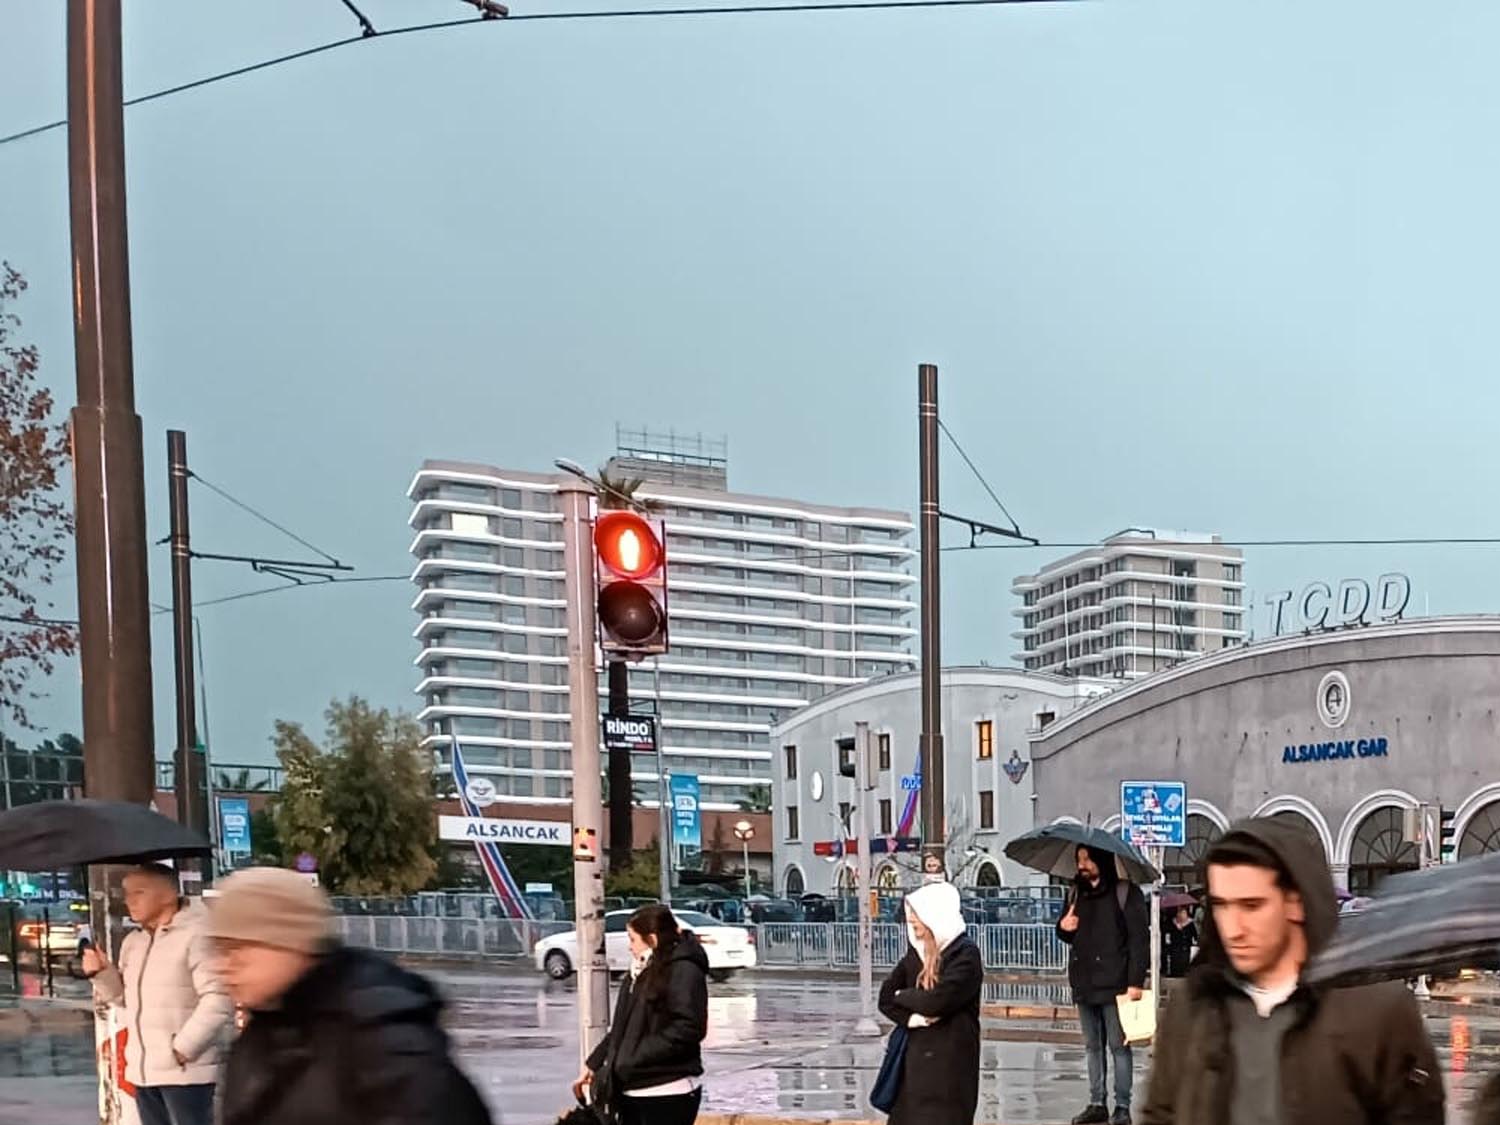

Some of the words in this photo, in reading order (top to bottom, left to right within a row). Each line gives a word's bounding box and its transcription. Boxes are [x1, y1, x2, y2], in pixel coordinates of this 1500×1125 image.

[1265, 572, 1411, 637] TCDD
[1282, 740, 1356, 764] ALSANCAK
[1357, 737, 1389, 758] GAR
[466, 823, 560, 840] ALSANCAK
